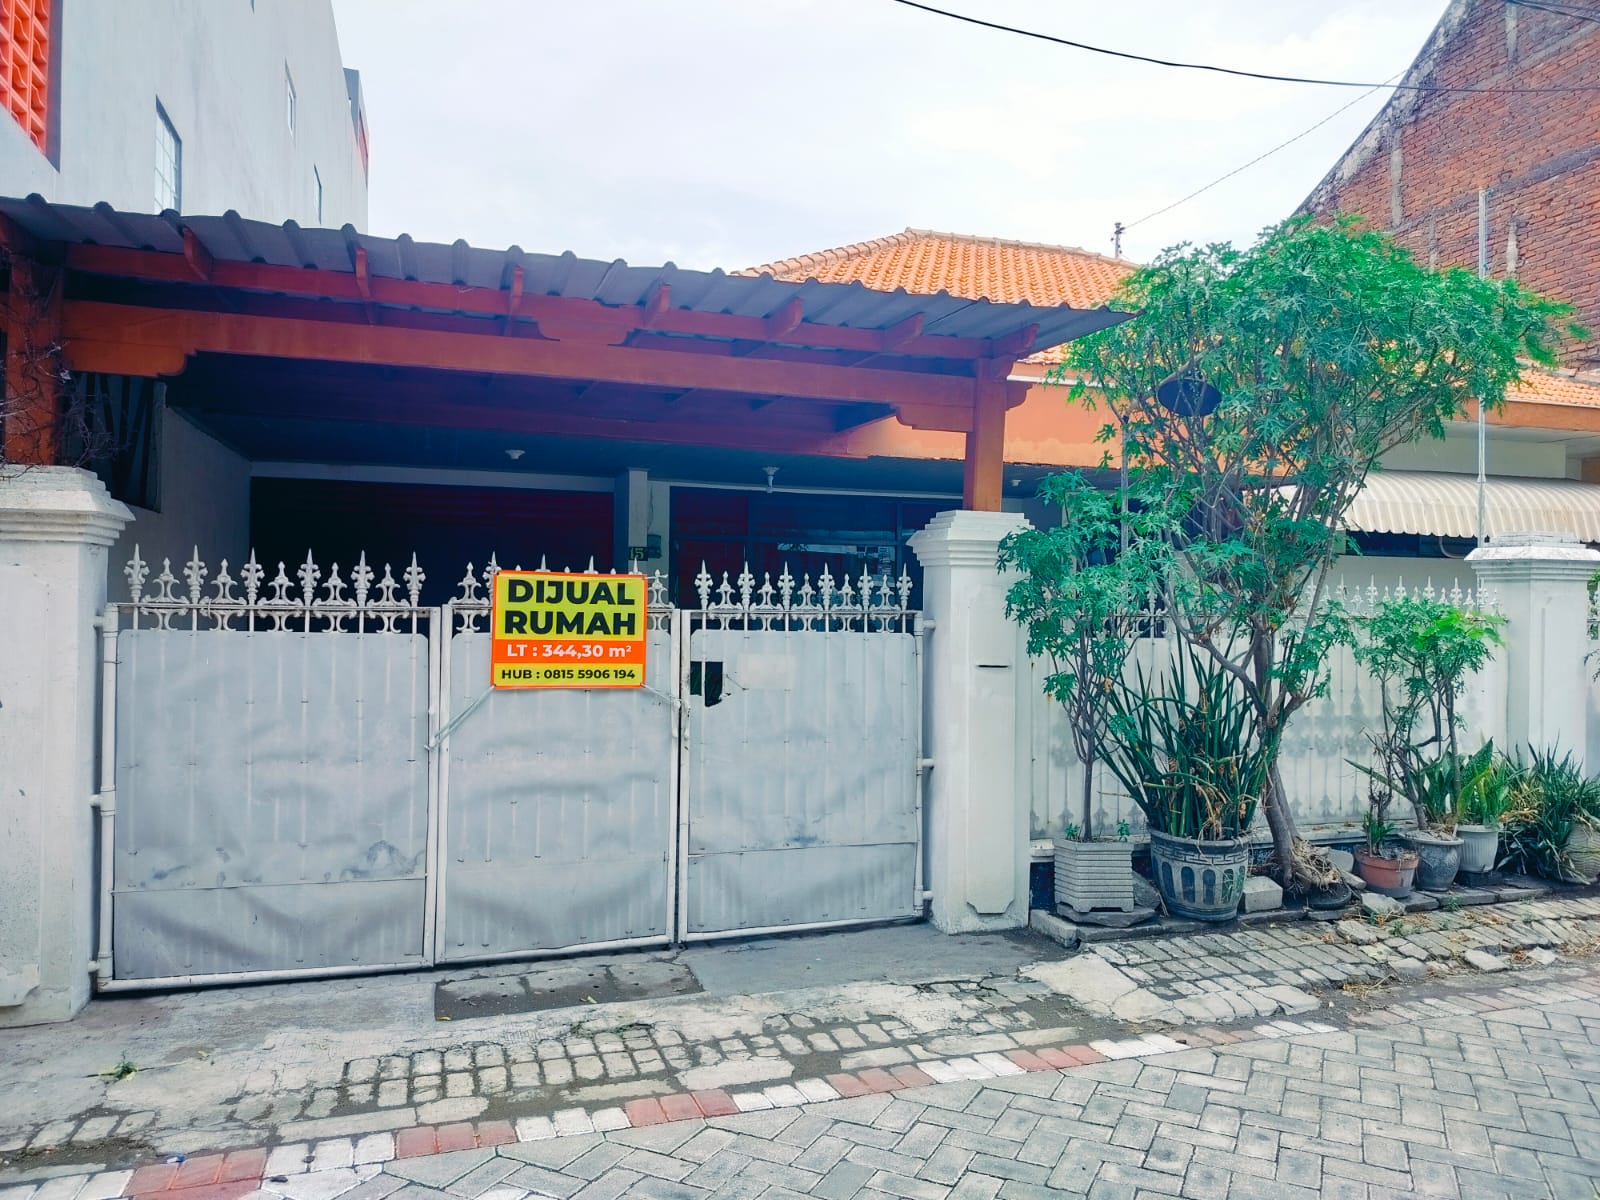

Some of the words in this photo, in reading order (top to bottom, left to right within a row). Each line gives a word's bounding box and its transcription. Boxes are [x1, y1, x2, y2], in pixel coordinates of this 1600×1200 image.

[508, 579, 635, 606] DIJUAL
[504, 610, 636, 635] RUMAH
[507, 644, 528, 657] LT
[542, 644, 604, 659] 344,30
[501, 669, 533, 679] HUB
[543, 669, 574, 679] 0815
[577, 669, 610, 679] 5906
[613, 669, 636, 679] 194
